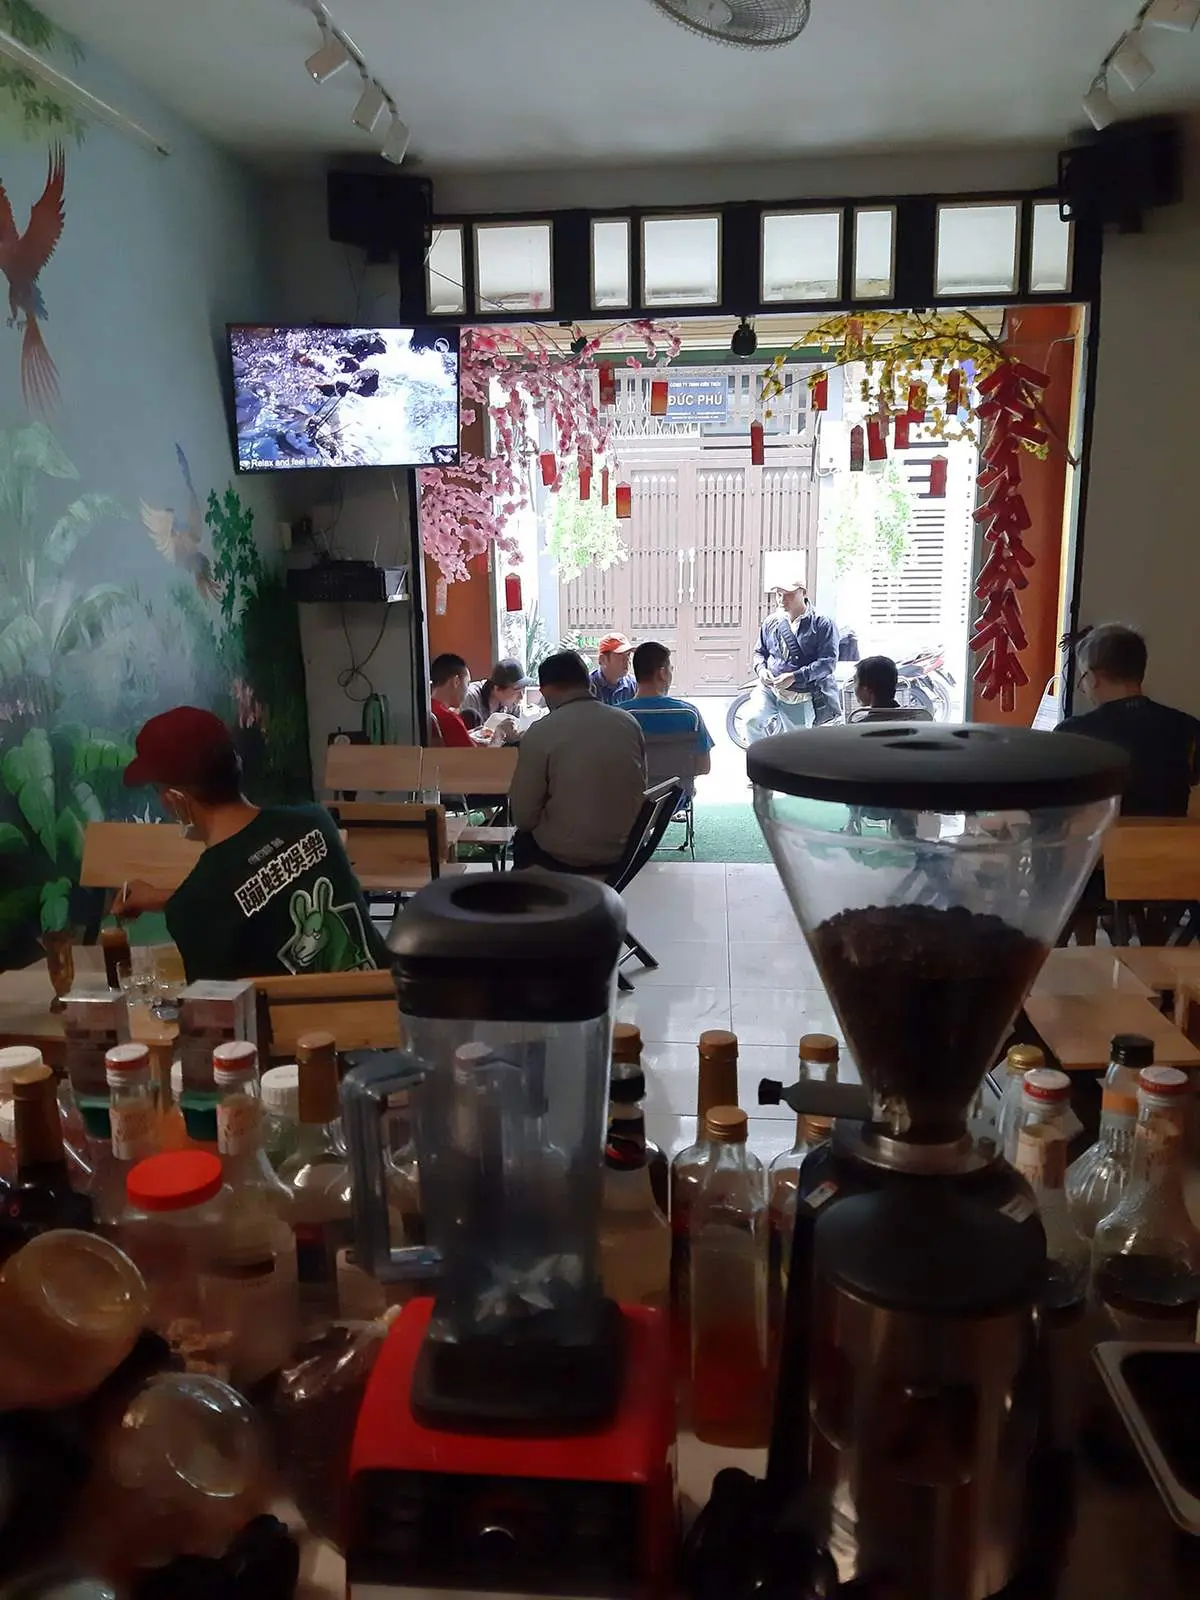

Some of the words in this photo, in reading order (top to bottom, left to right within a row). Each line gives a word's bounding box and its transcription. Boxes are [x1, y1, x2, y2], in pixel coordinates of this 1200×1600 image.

[668, 392, 694, 406] ĐỨC
[697, 391, 722, 406] PHÚ
[251, 459, 274, 468] Relax
[275, 458, 290, 467] and
[291, 458, 306, 467] feel
